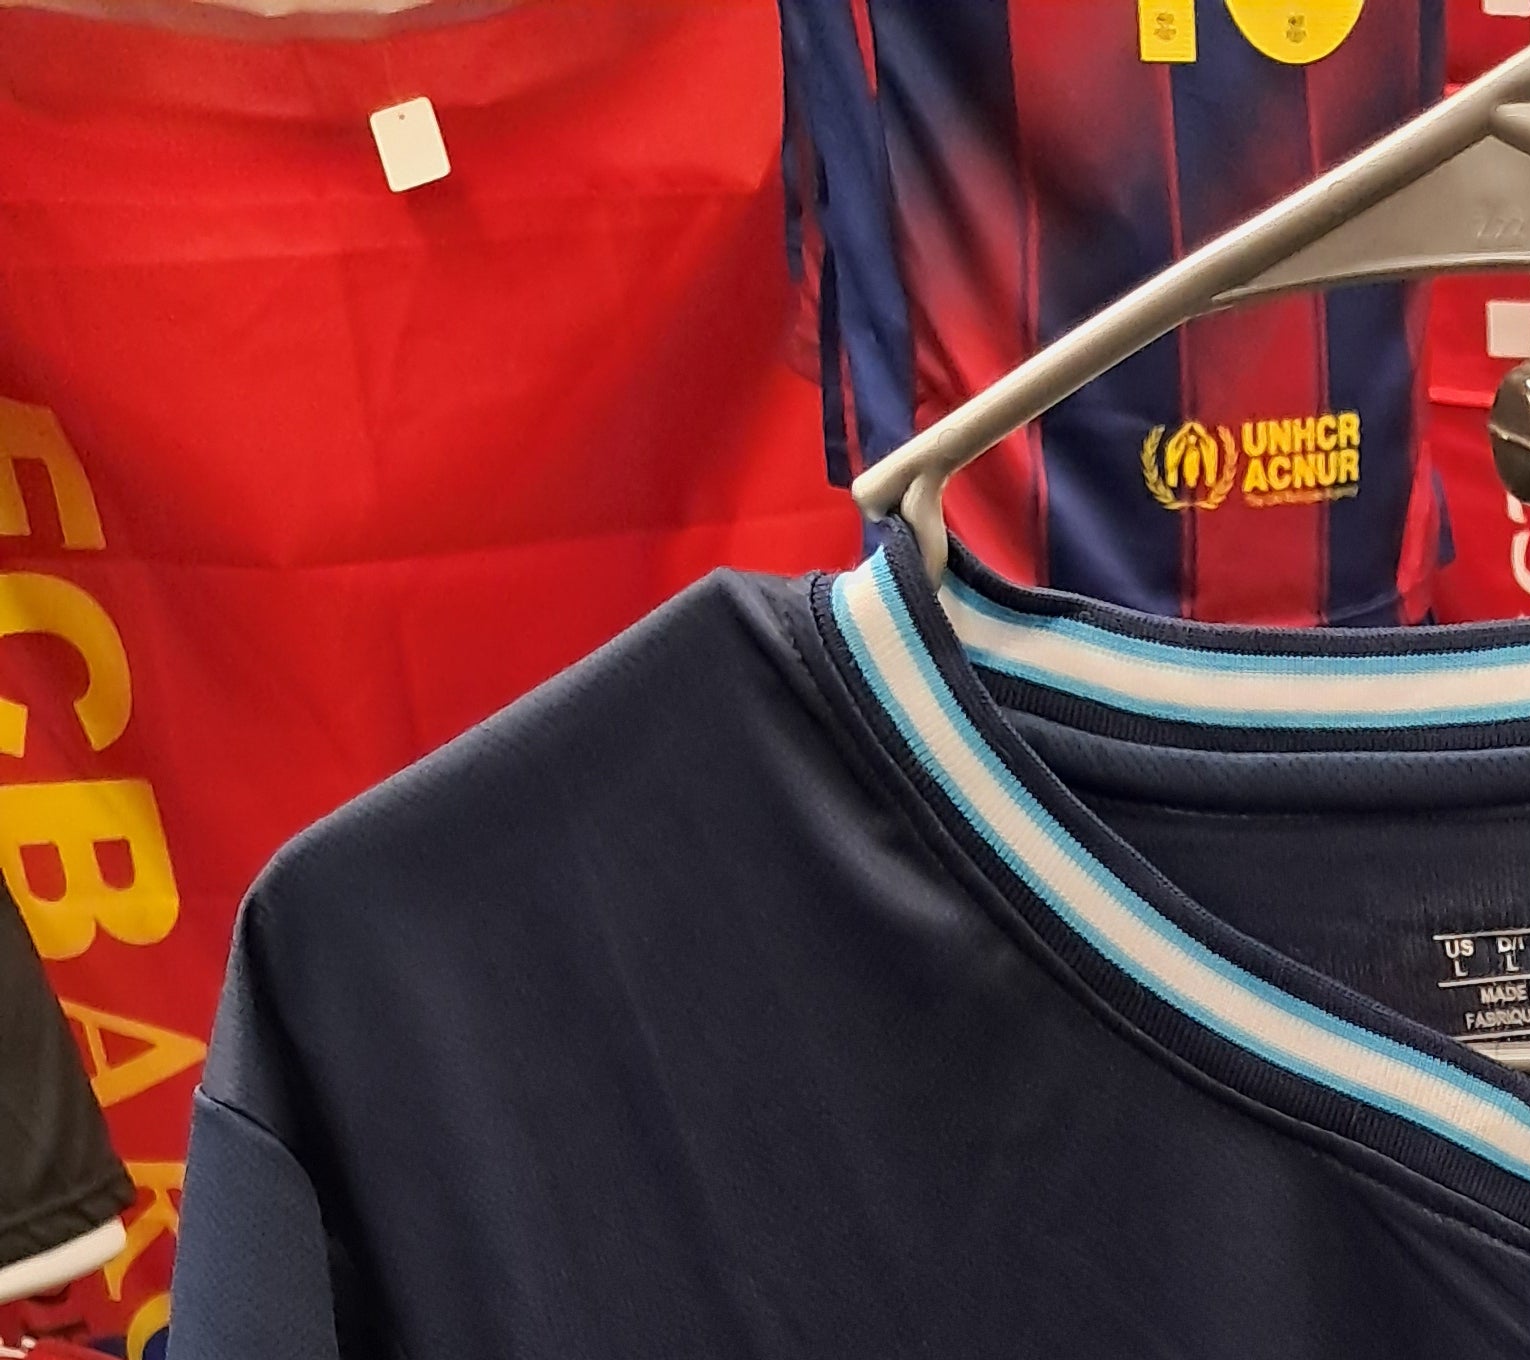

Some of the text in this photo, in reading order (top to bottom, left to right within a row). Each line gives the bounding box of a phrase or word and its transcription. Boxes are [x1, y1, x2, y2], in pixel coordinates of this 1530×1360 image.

[1241, 410, 1361, 457] UNHCR
[1242, 448, 1360, 493] ACNUR
[1445, 939, 1474, 958] US
[1454, 958, 1470, 978] L
[1505, 953, 1520, 973] L
[1481, 984, 1527, 1004] MADE
